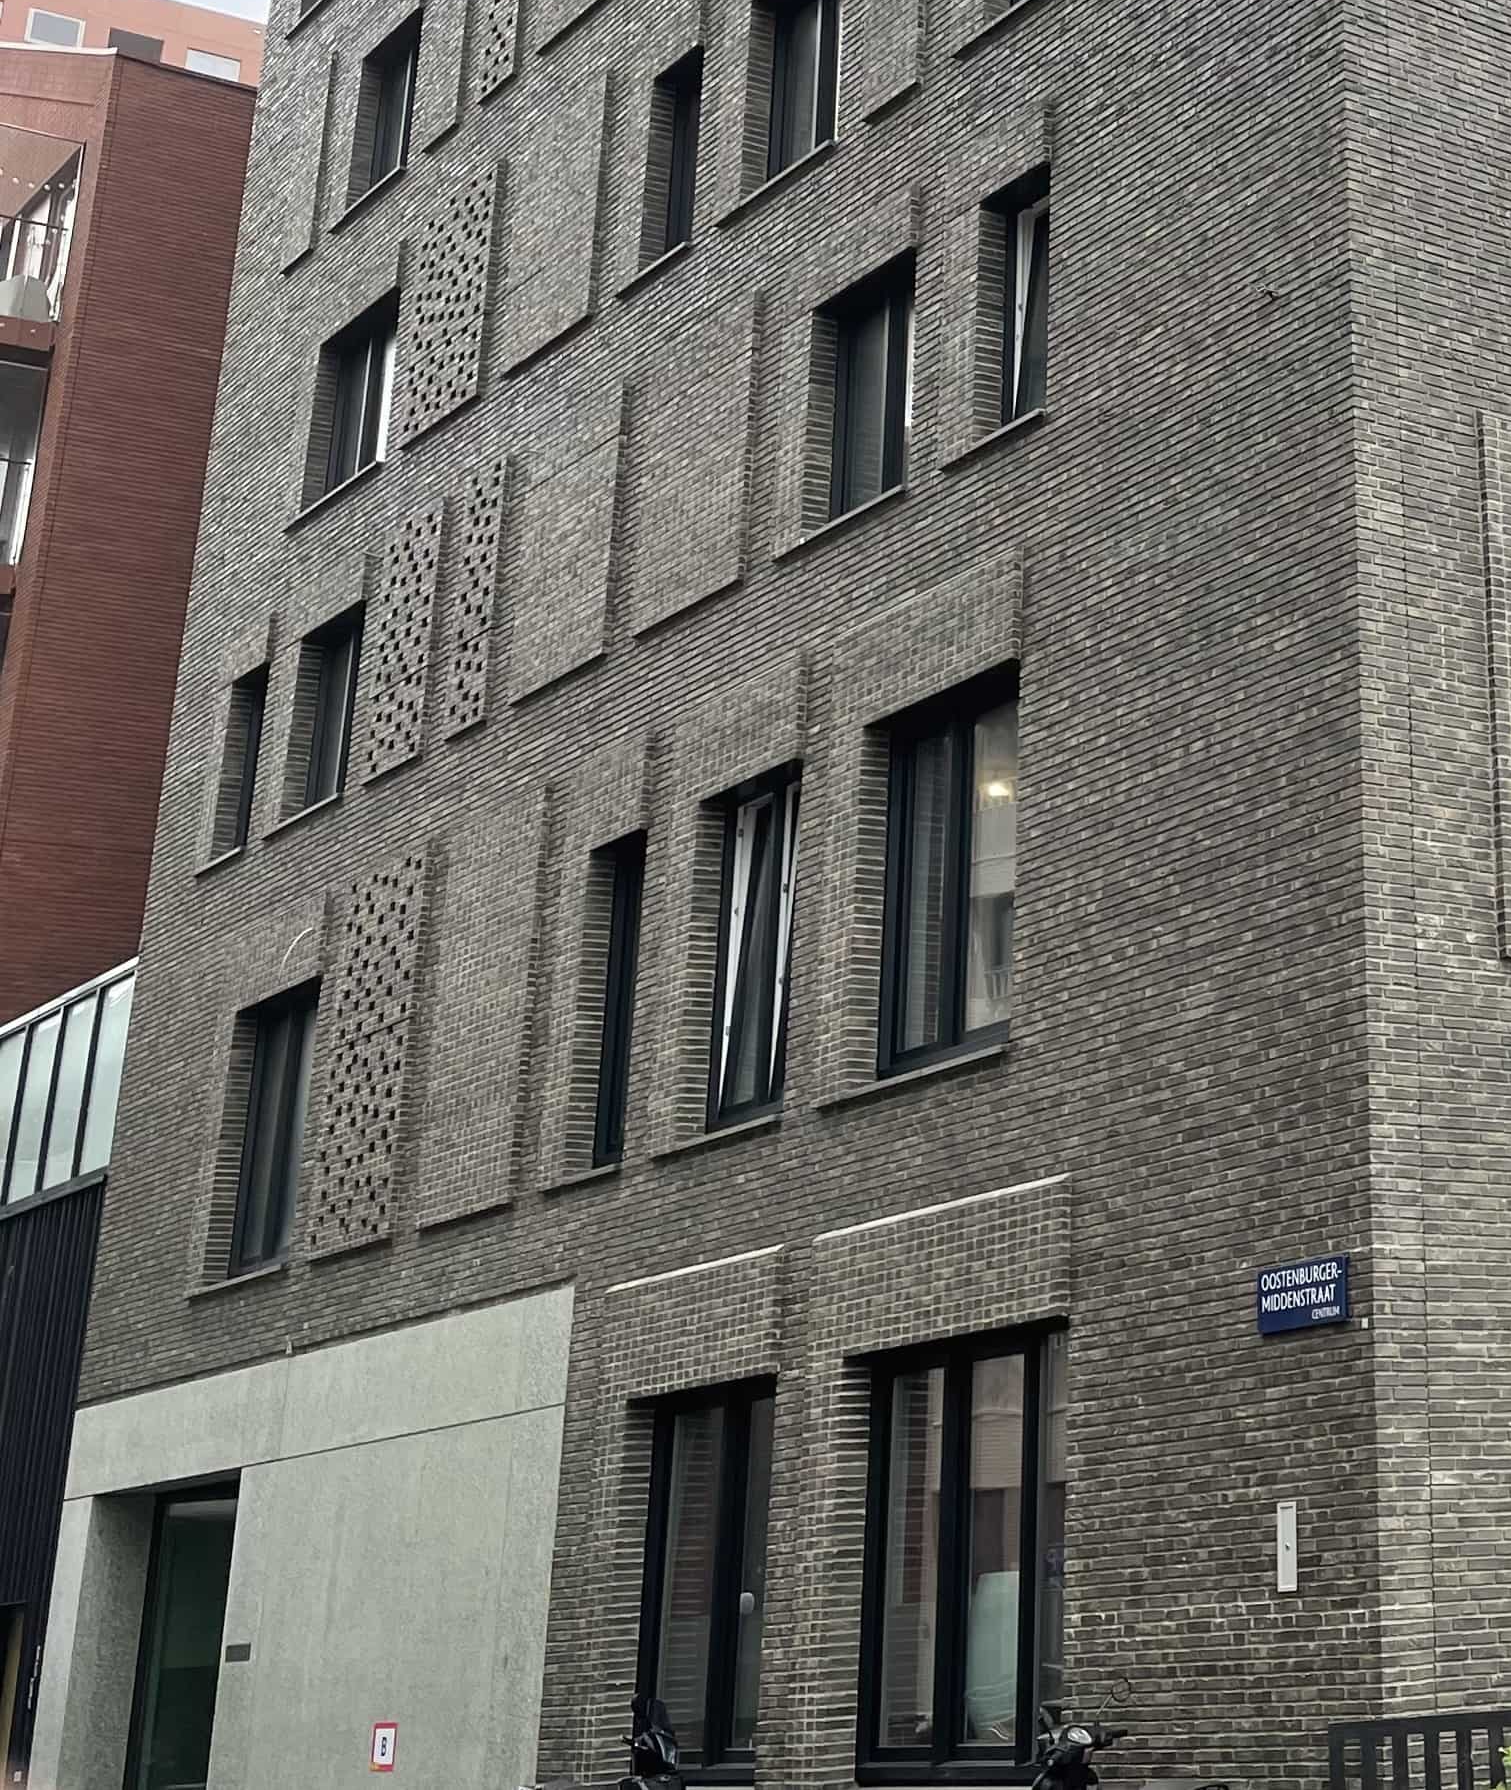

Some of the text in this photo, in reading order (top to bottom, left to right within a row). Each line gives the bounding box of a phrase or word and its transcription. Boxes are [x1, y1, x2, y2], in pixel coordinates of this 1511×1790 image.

[1261, 1262, 1342, 1291] OOSTENBURGER-
[1262, 1283, 1336, 1313] MIDDENSTRAAT
[1311, 1306, 1340, 1319] CENTRUM
